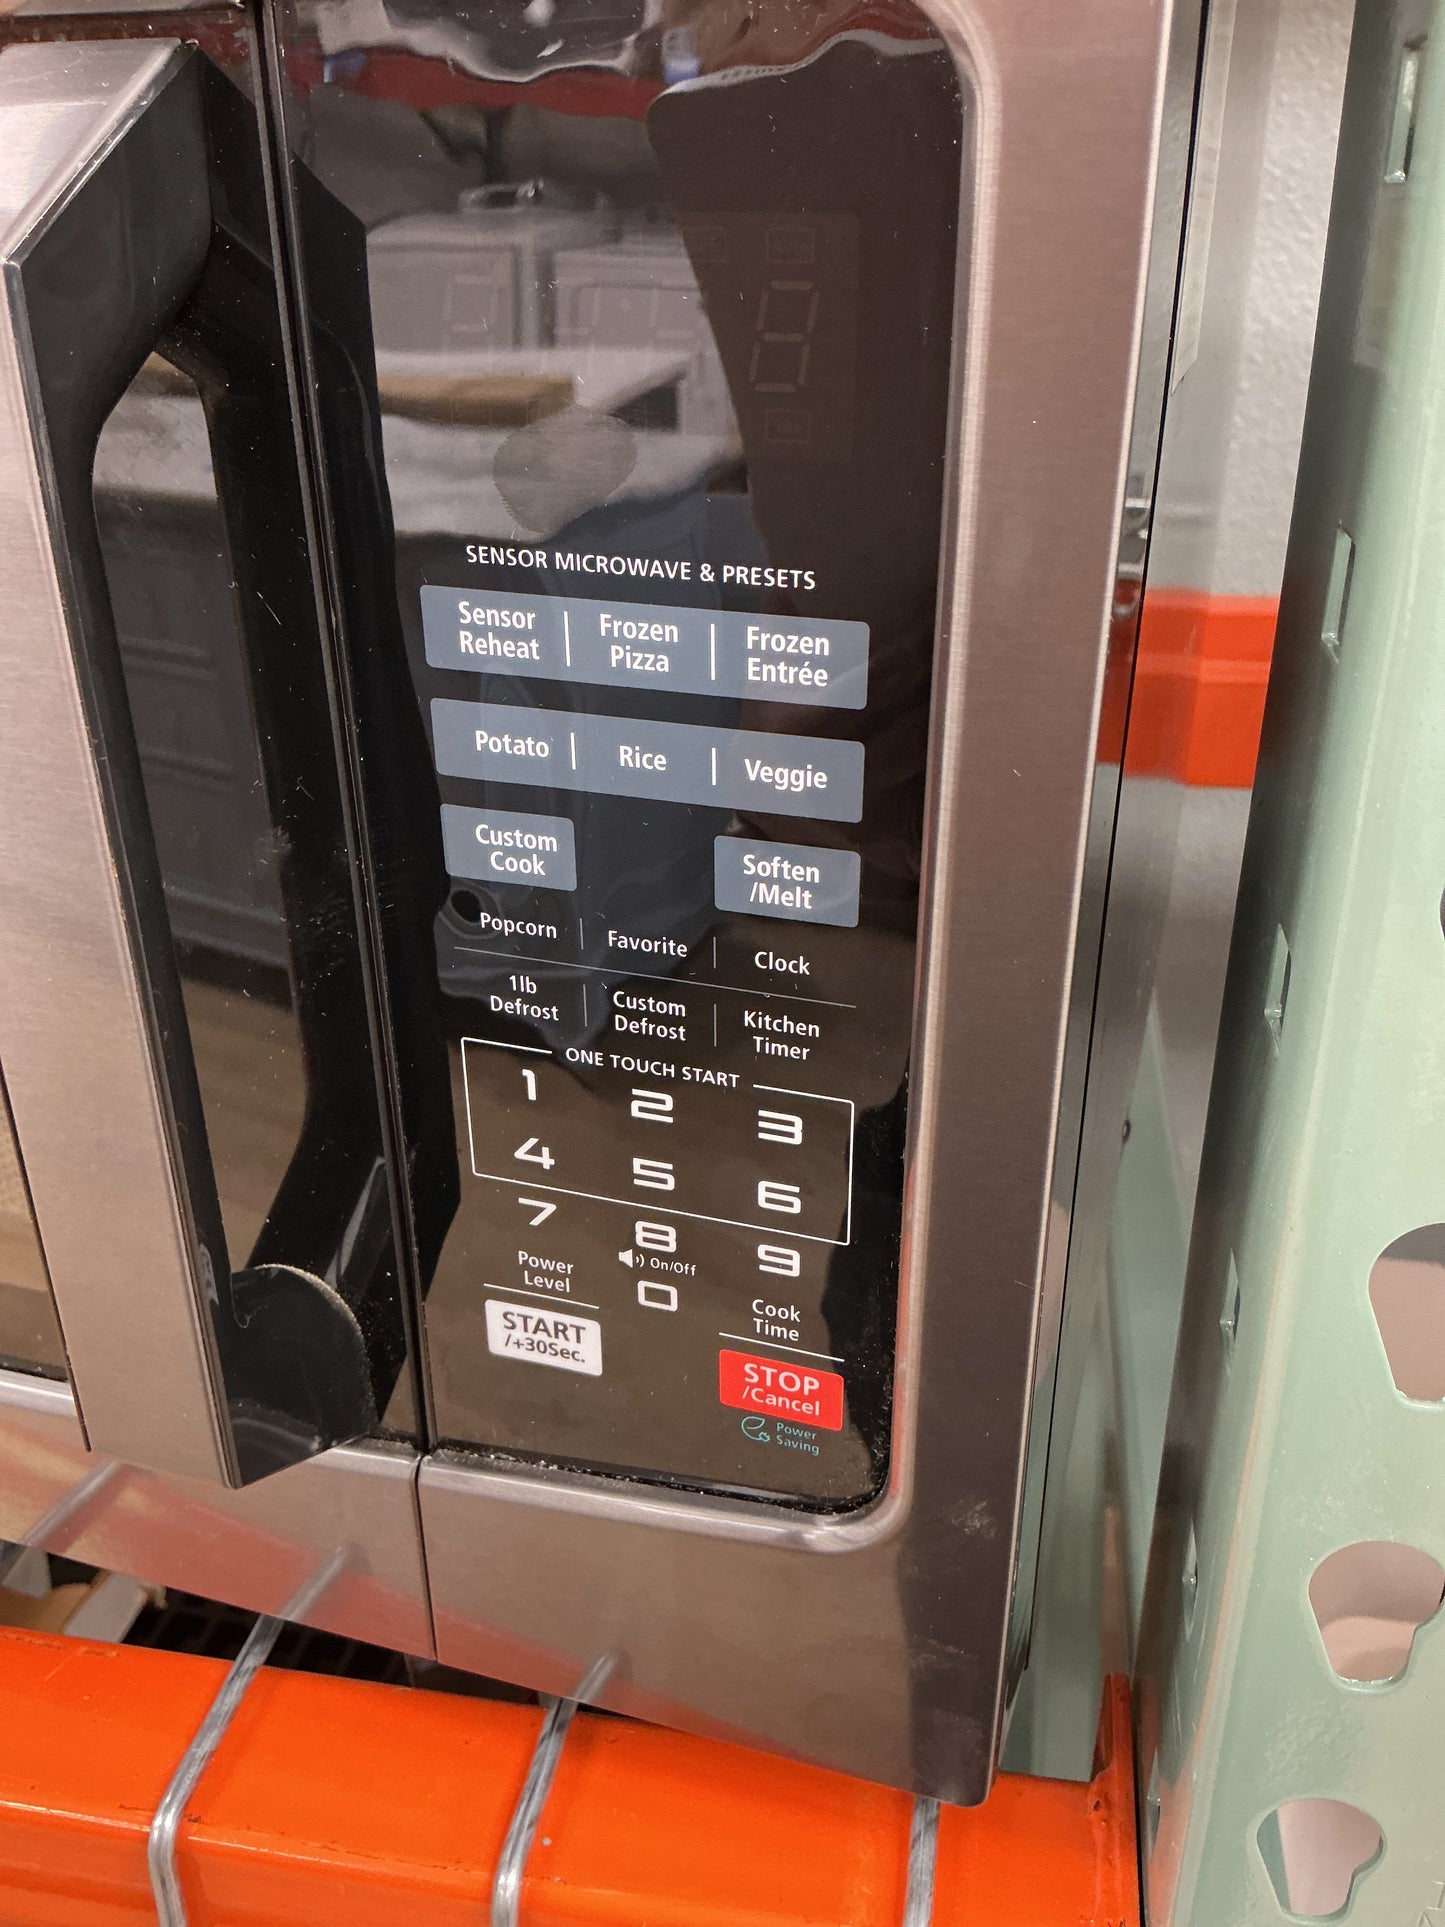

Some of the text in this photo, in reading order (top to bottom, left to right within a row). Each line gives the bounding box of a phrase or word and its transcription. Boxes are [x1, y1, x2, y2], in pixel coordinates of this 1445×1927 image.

[466, 545, 816, 590] SENSOR MICROWAVE & PRESETS
[458, 601, 536, 629] Sensor
[600, 614, 679, 643] Frozen
[459, 631, 540, 660] Reheat
[747, 626, 830, 656] Frozen
[611, 645, 670, 672] Pizza
[747, 658, 829, 687] Entrée
[475, 730, 550, 758] Potato
[619, 746, 667, 771] Rice
[744, 759, 828, 791] Veggie
[475, 824, 558, 852] Custom
[490, 852, 545, 875] Cook
[743, 854, 820, 883] Soften
[750, 881, 812, 909] /Melt
[480, 912, 557, 939] Popcorn
[608, 930, 688, 958] Favorite
[754, 952, 810, 975] Clock
[509, 976, 537, 994] 1lb
[490, 995, 559, 1021] Defrost
[613, 992, 686, 1017] Custom
[615, 1015, 686, 1042] Defrost
[744, 1011, 820, 1038] Kitchen
[753, 1036, 810, 1061] Timer
[566, 1048, 740, 1088] ONE TOUCH START
[522, 1069, 536, 1101] 1
[631, 1089, 673, 1123] 2
[758, 1110, 802, 1145] 3
[514, 1138, 555, 1170] 4
[633, 1158, 675, 1191] 5
[518, 1197, 557, 1226] 7
[757, 1181, 801, 1214] 6
[635, 1221, 677, 1252] 8
[518, 1250, 573, 1275] Power
[650, 1257, 697, 1277] On/Off
[757, 1245, 800, 1277] 9
[524, 1270, 570, 1293] Level
[638, 1281, 678, 1311] 0
[752, 1299, 800, 1323] Cook
[503, 1311, 586, 1344] START
[753, 1318, 799, 1342] Time
[504, 1333, 586, 1364] /+30Sec.
[744, 1363, 820, 1396] STOP
[742, 1385, 820, 1417] /Cancel
[776, 1422, 817, 1440] Power
[776, 1435, 820, 1456] Saving
